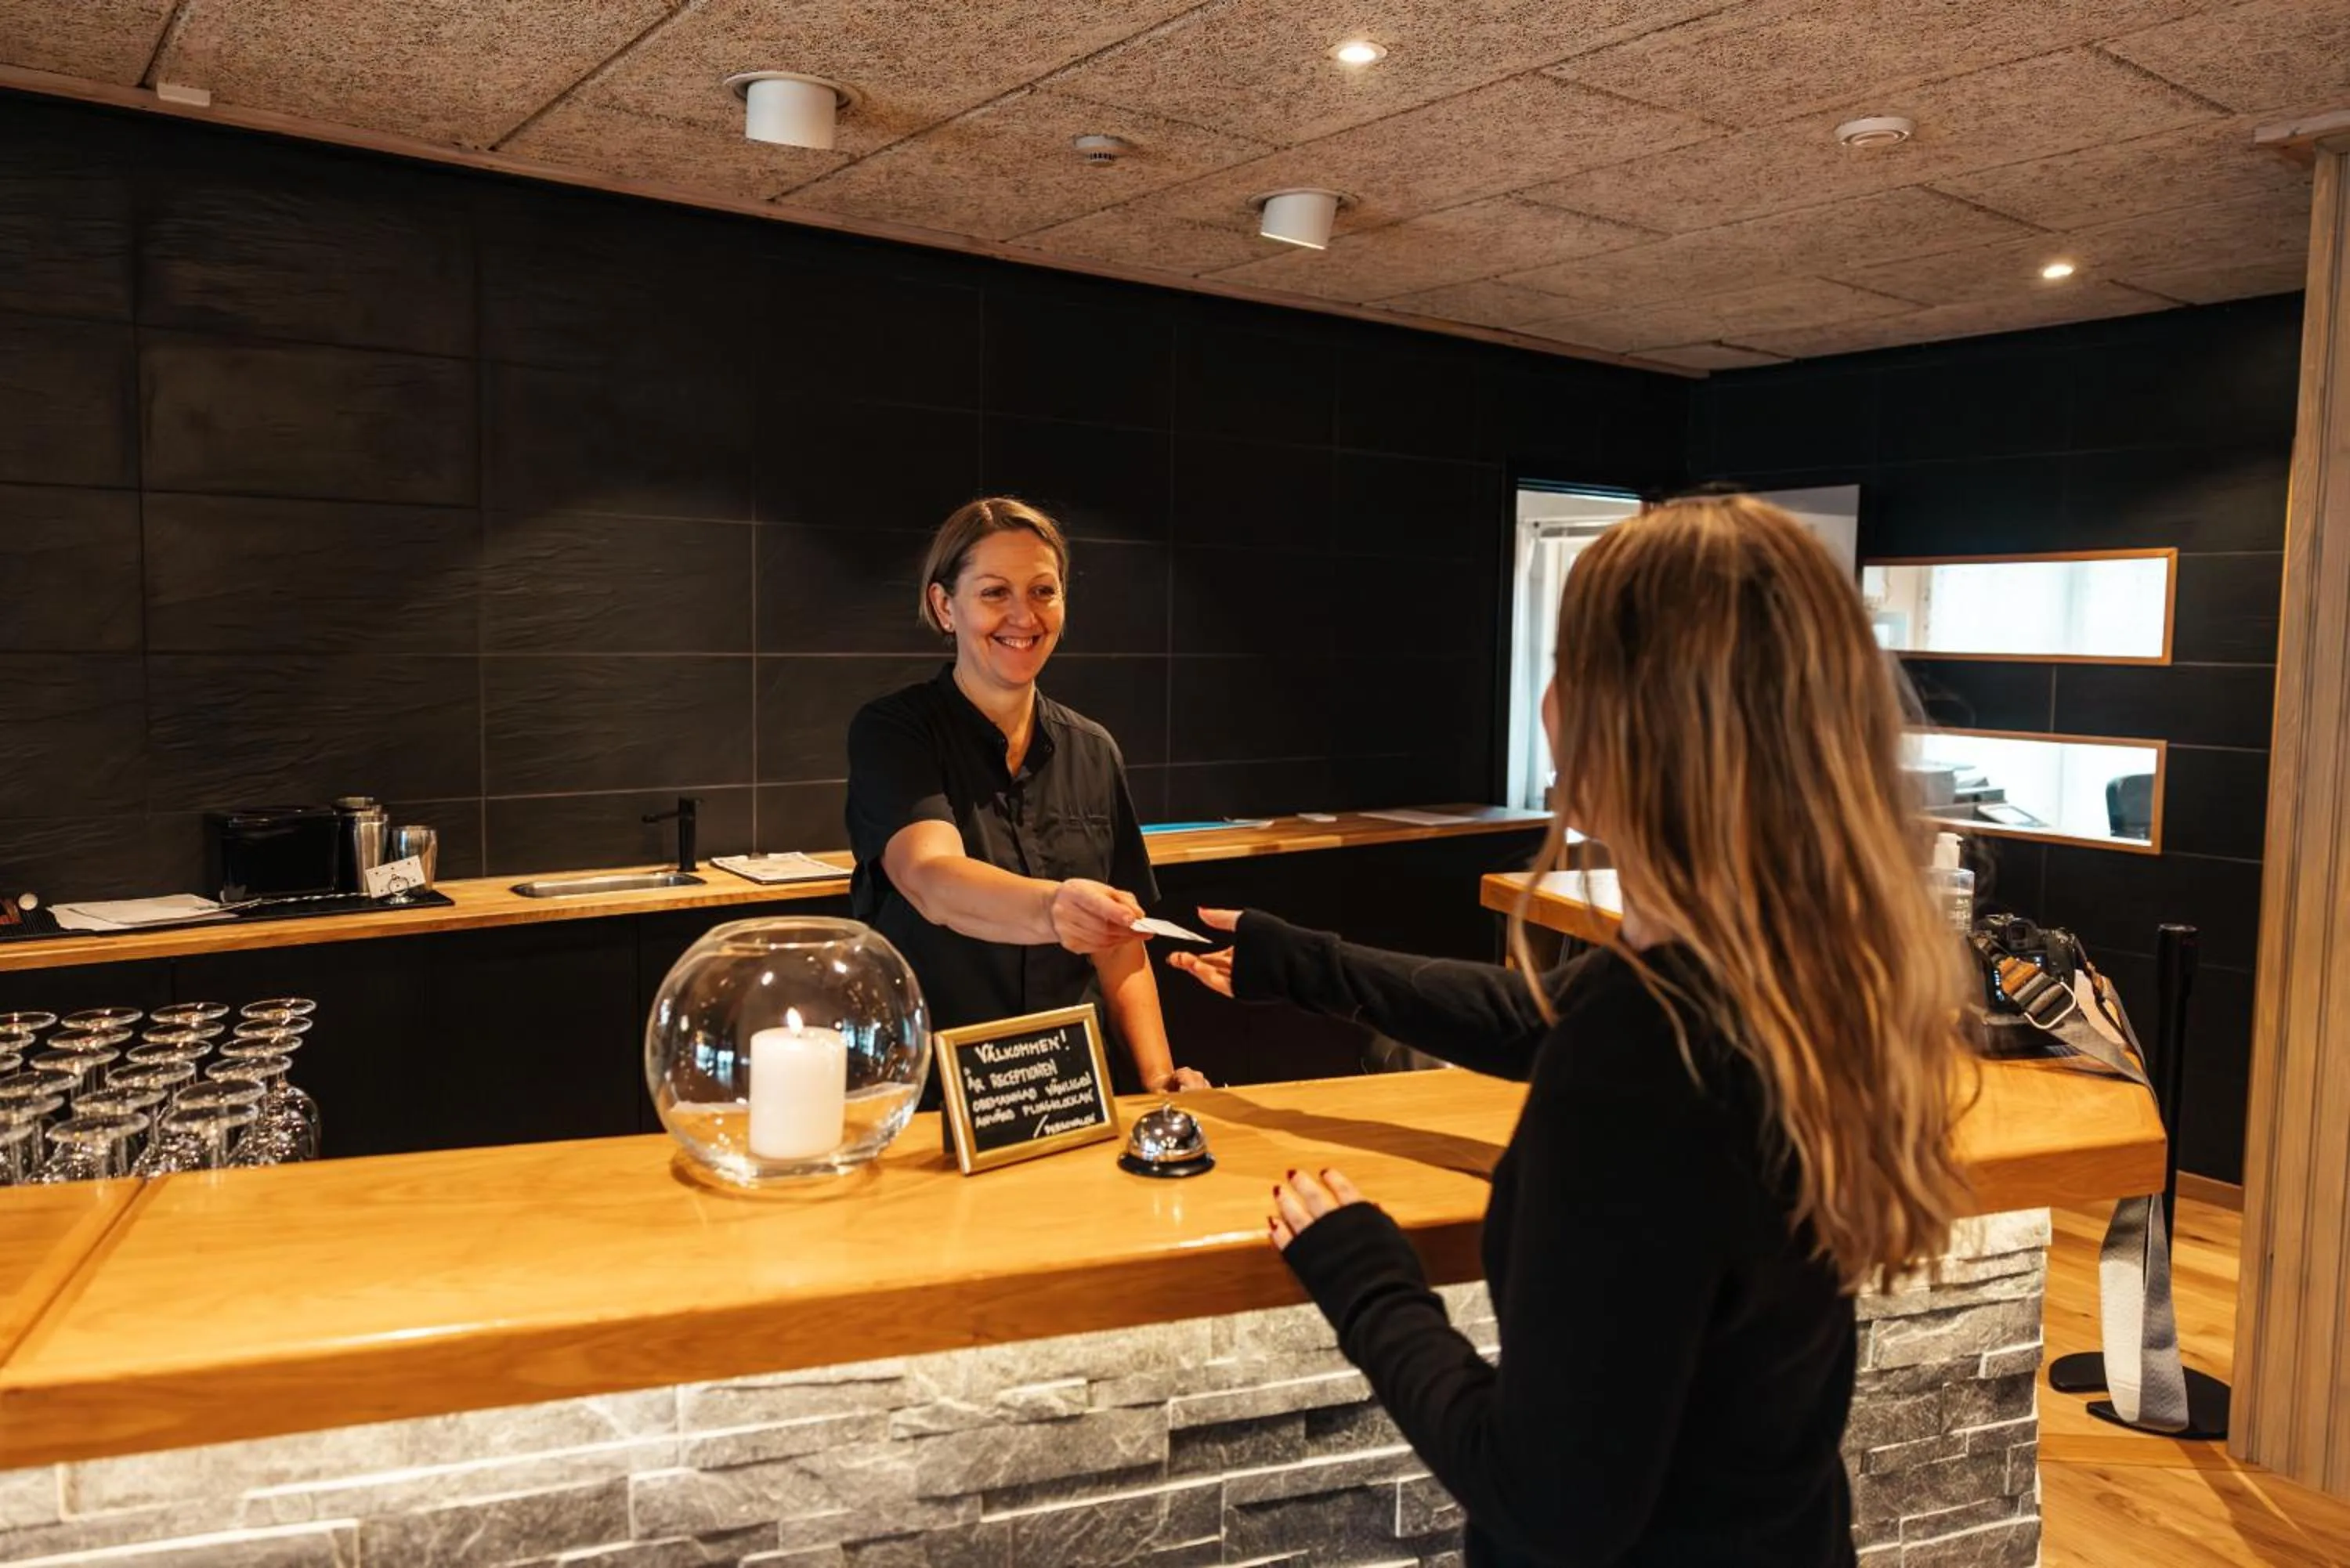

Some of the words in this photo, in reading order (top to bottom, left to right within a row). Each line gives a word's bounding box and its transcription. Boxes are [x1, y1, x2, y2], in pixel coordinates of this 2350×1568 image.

[975, 1029, 1070, 1064] VÄLKOMMEN!
[990, 1059, 1058, 1088] RECEPTIONEN
[1045, 1071, 1093, 1096] VÄNLIGEN
